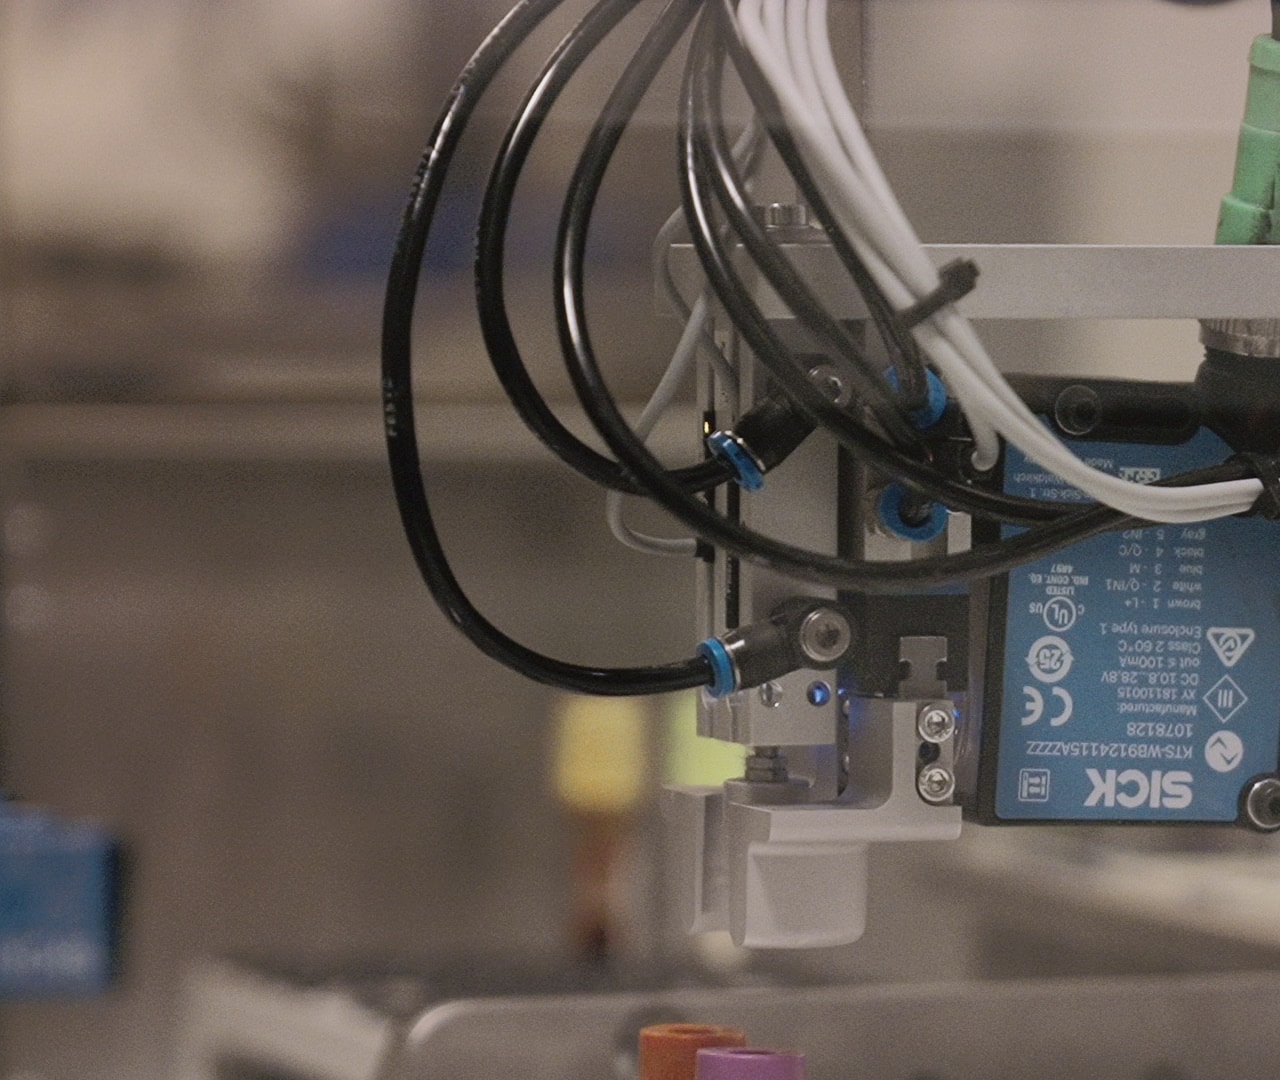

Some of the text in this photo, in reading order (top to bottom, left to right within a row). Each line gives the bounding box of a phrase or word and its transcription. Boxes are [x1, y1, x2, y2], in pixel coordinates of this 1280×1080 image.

[1046, 586, 1074, 595] LISTED
[1172, 581, 1202, 594] white
[1028, 602, 1043, 614] US
[1167, 599, 1201, 611] brown
[1100, 621, 1202, 639] Enclosure type 1
[1155, 640, 1164, 653] 2
[1168, 640, 1201, 654] Class
[1039, 648, 1062, 670] 25
[1119, 656, 1164, 668] 100mA
[1179, 657, 1200, 669] out
[1180, 673, 1199, 686] DC
[1117, 686, 1196, 700] XY 18110015
[1116, 702, 1197, 716] Manufactured:
[1127, 722, 1192, 738] 1078128
[1026, 740, 1192, 759] KTS-WB9124115AZZZZ
[1084, 768, 1193, 808] SICK
